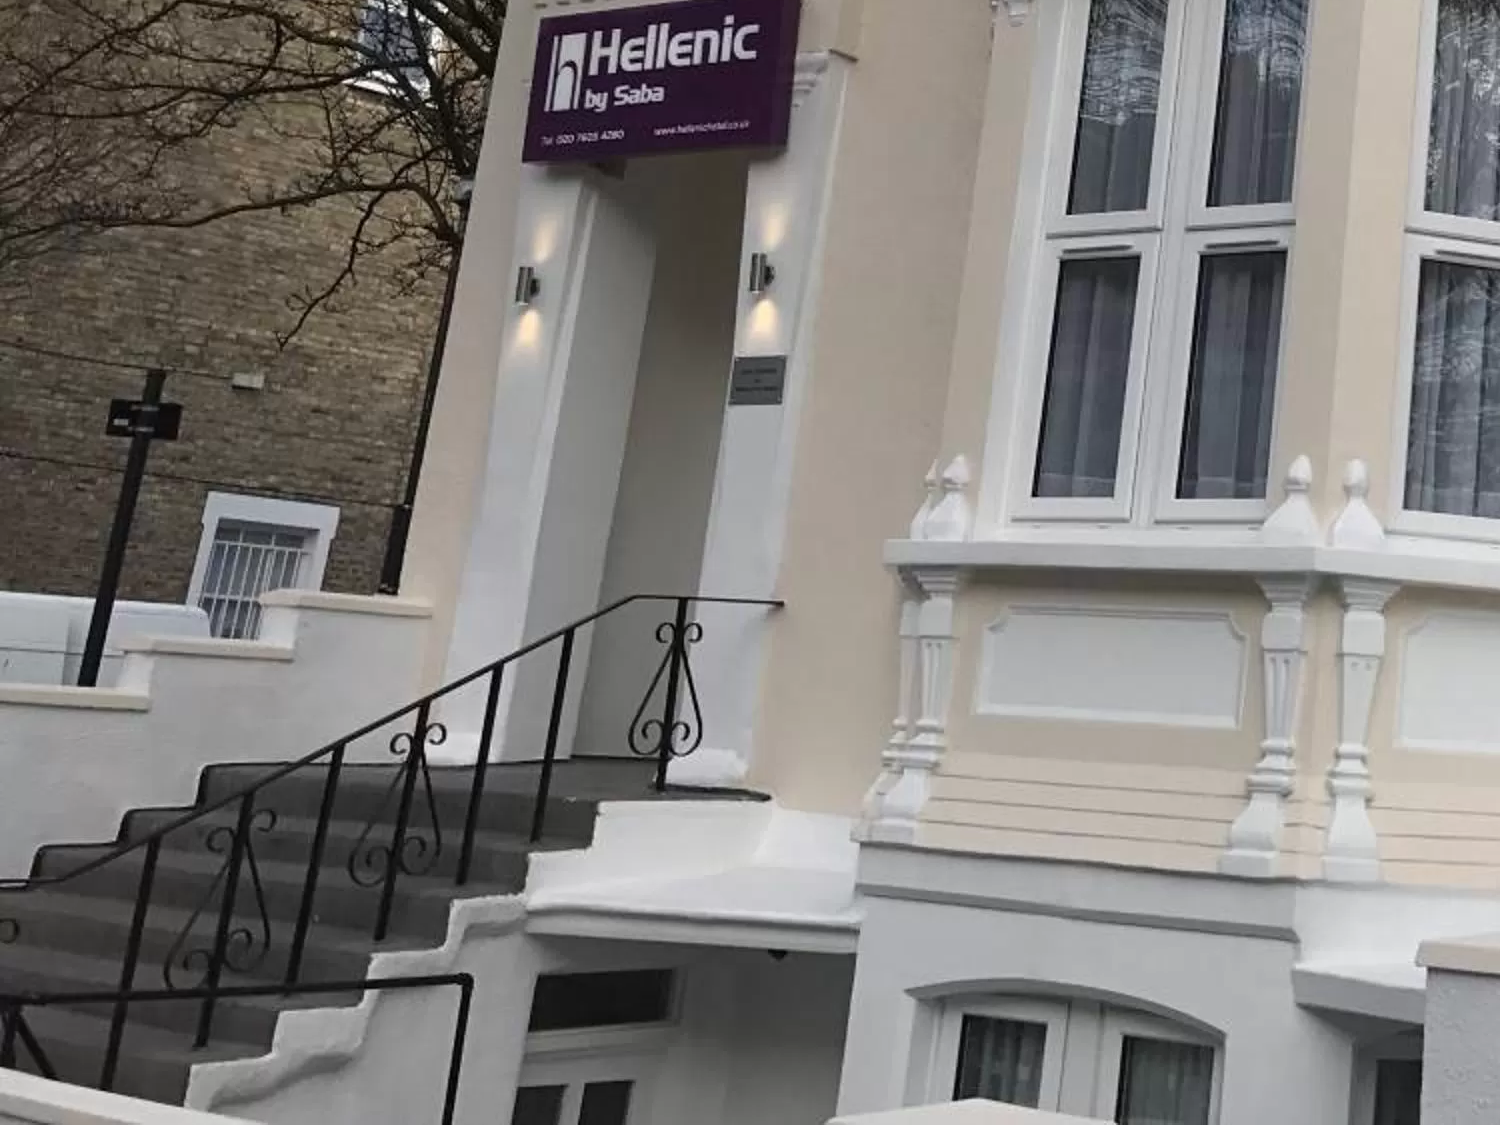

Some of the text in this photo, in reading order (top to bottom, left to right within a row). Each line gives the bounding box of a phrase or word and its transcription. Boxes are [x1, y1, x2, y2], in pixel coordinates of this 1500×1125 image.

[587, 15, 759, 76] Hellenic
[584, 82, 665, 112] by Saba
